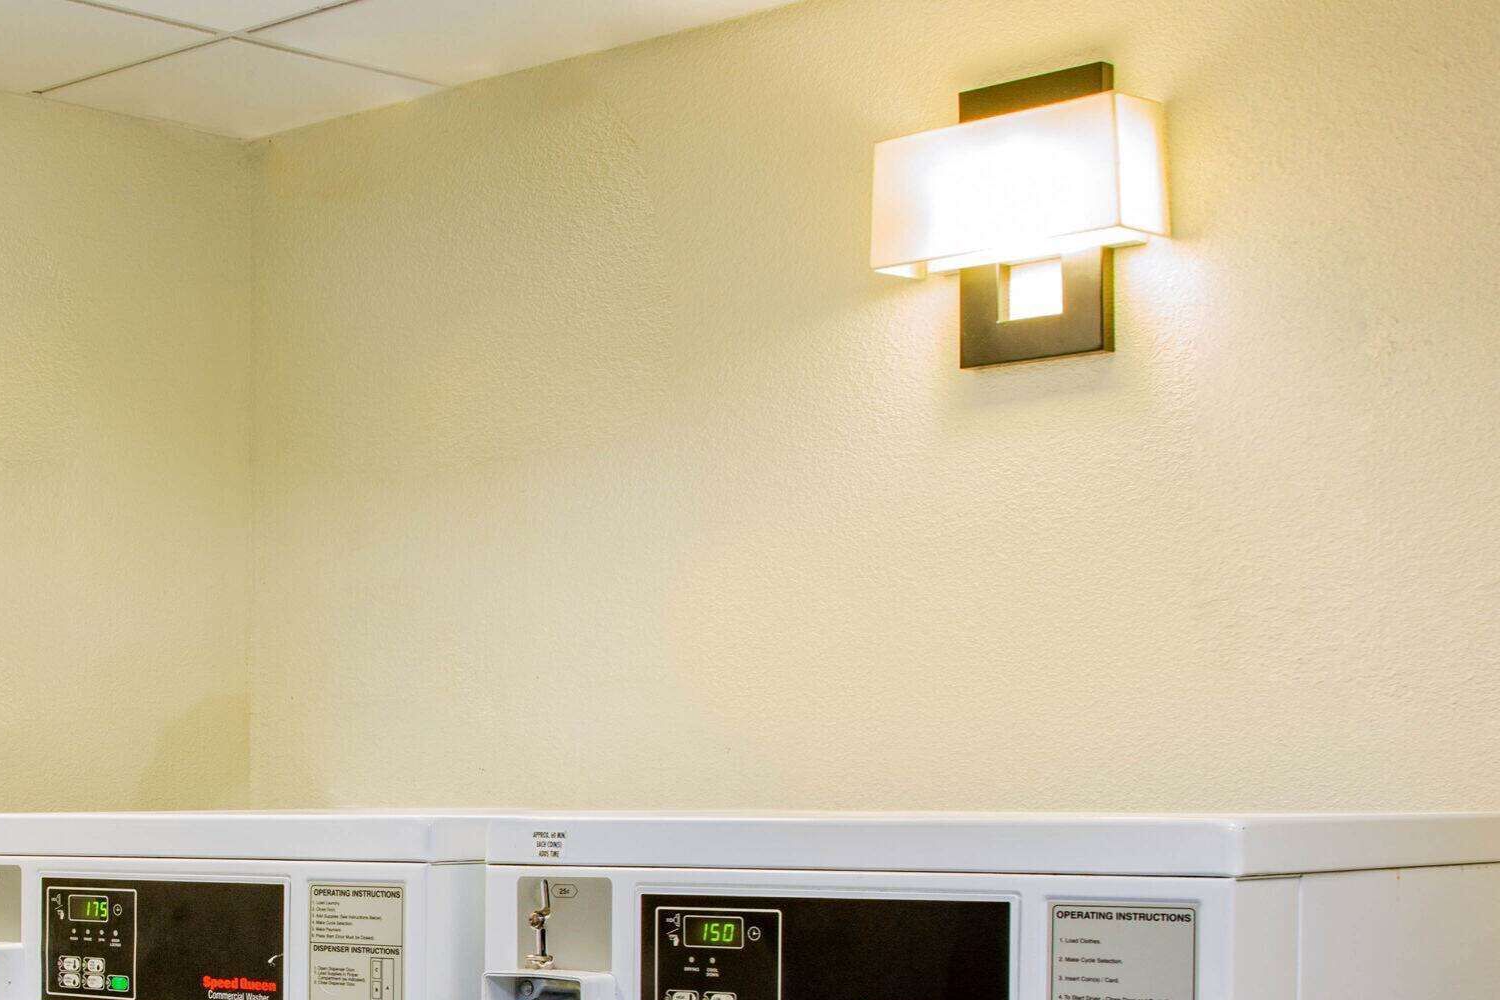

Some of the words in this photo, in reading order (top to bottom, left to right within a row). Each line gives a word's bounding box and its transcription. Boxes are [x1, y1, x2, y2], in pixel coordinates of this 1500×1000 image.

[313, 888, 350, 897] OPERATING
[352, 890, 401, 899] INSTRUCTIONS
[87, 901, 108, 917] 175
[1056, 911, 1113, 920] OPERATING
[1115, 912, 1192, 922] INSTRUCTIONS
[703, 923, 735, 942] 150
[313, 945, 349, 953] DISPENSER
[351, 946, 400, 955] INSTRUCTIONS
[202, 975, 239, 989] Speed
[239, 977, 277, 992] Queen
[208, 990, 244, 1000] Commercial
